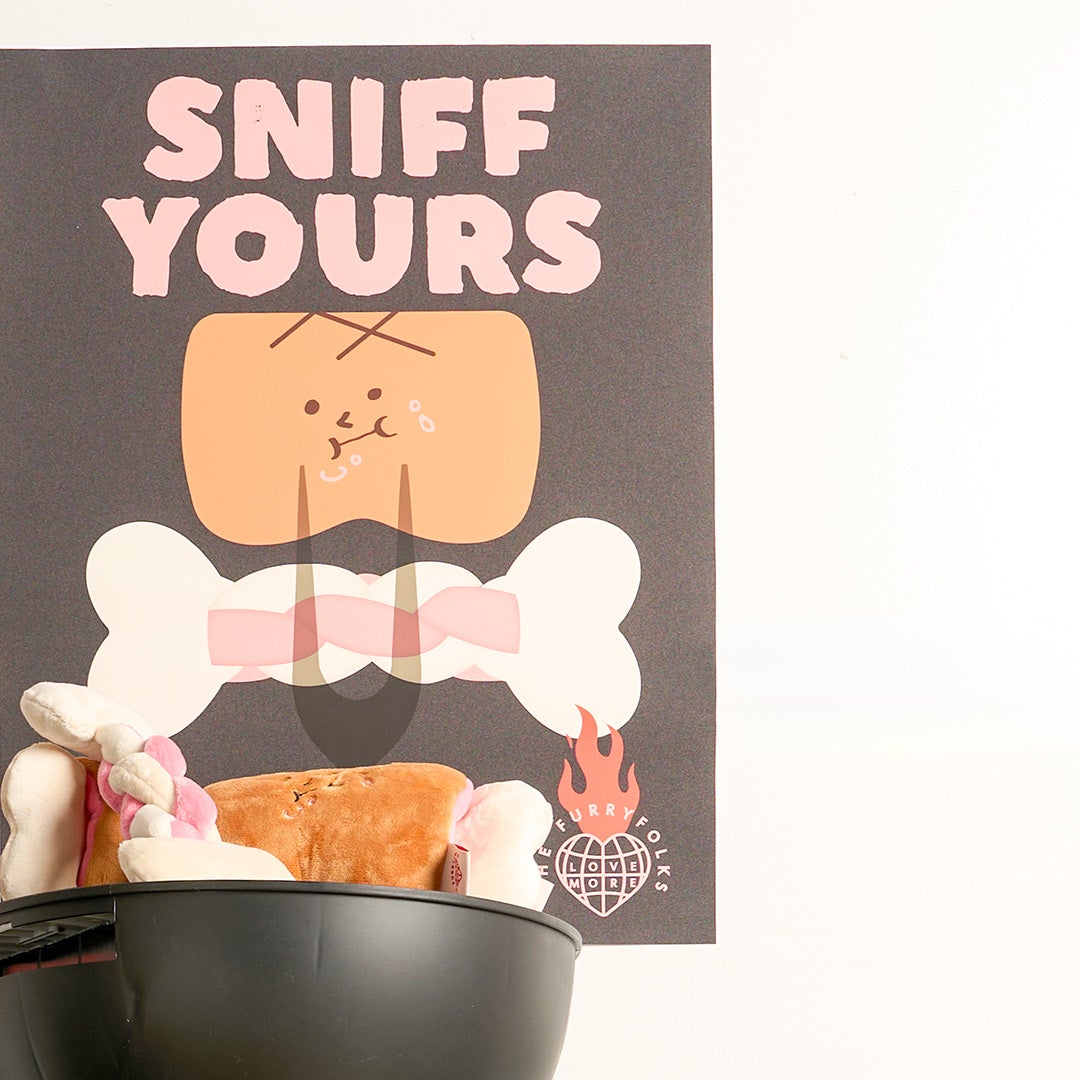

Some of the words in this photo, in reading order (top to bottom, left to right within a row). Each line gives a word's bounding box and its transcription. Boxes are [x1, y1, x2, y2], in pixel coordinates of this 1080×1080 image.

[143, 75, 556, 182] SNIFF
[101, 190, 602, 297] YOURS
[555, 803, 635, 833] FURRY
[635, 815, 671, 893] FOLKS
[569, 861, 638, 873] LOVE
[569, 878, 638, 889] MORE
